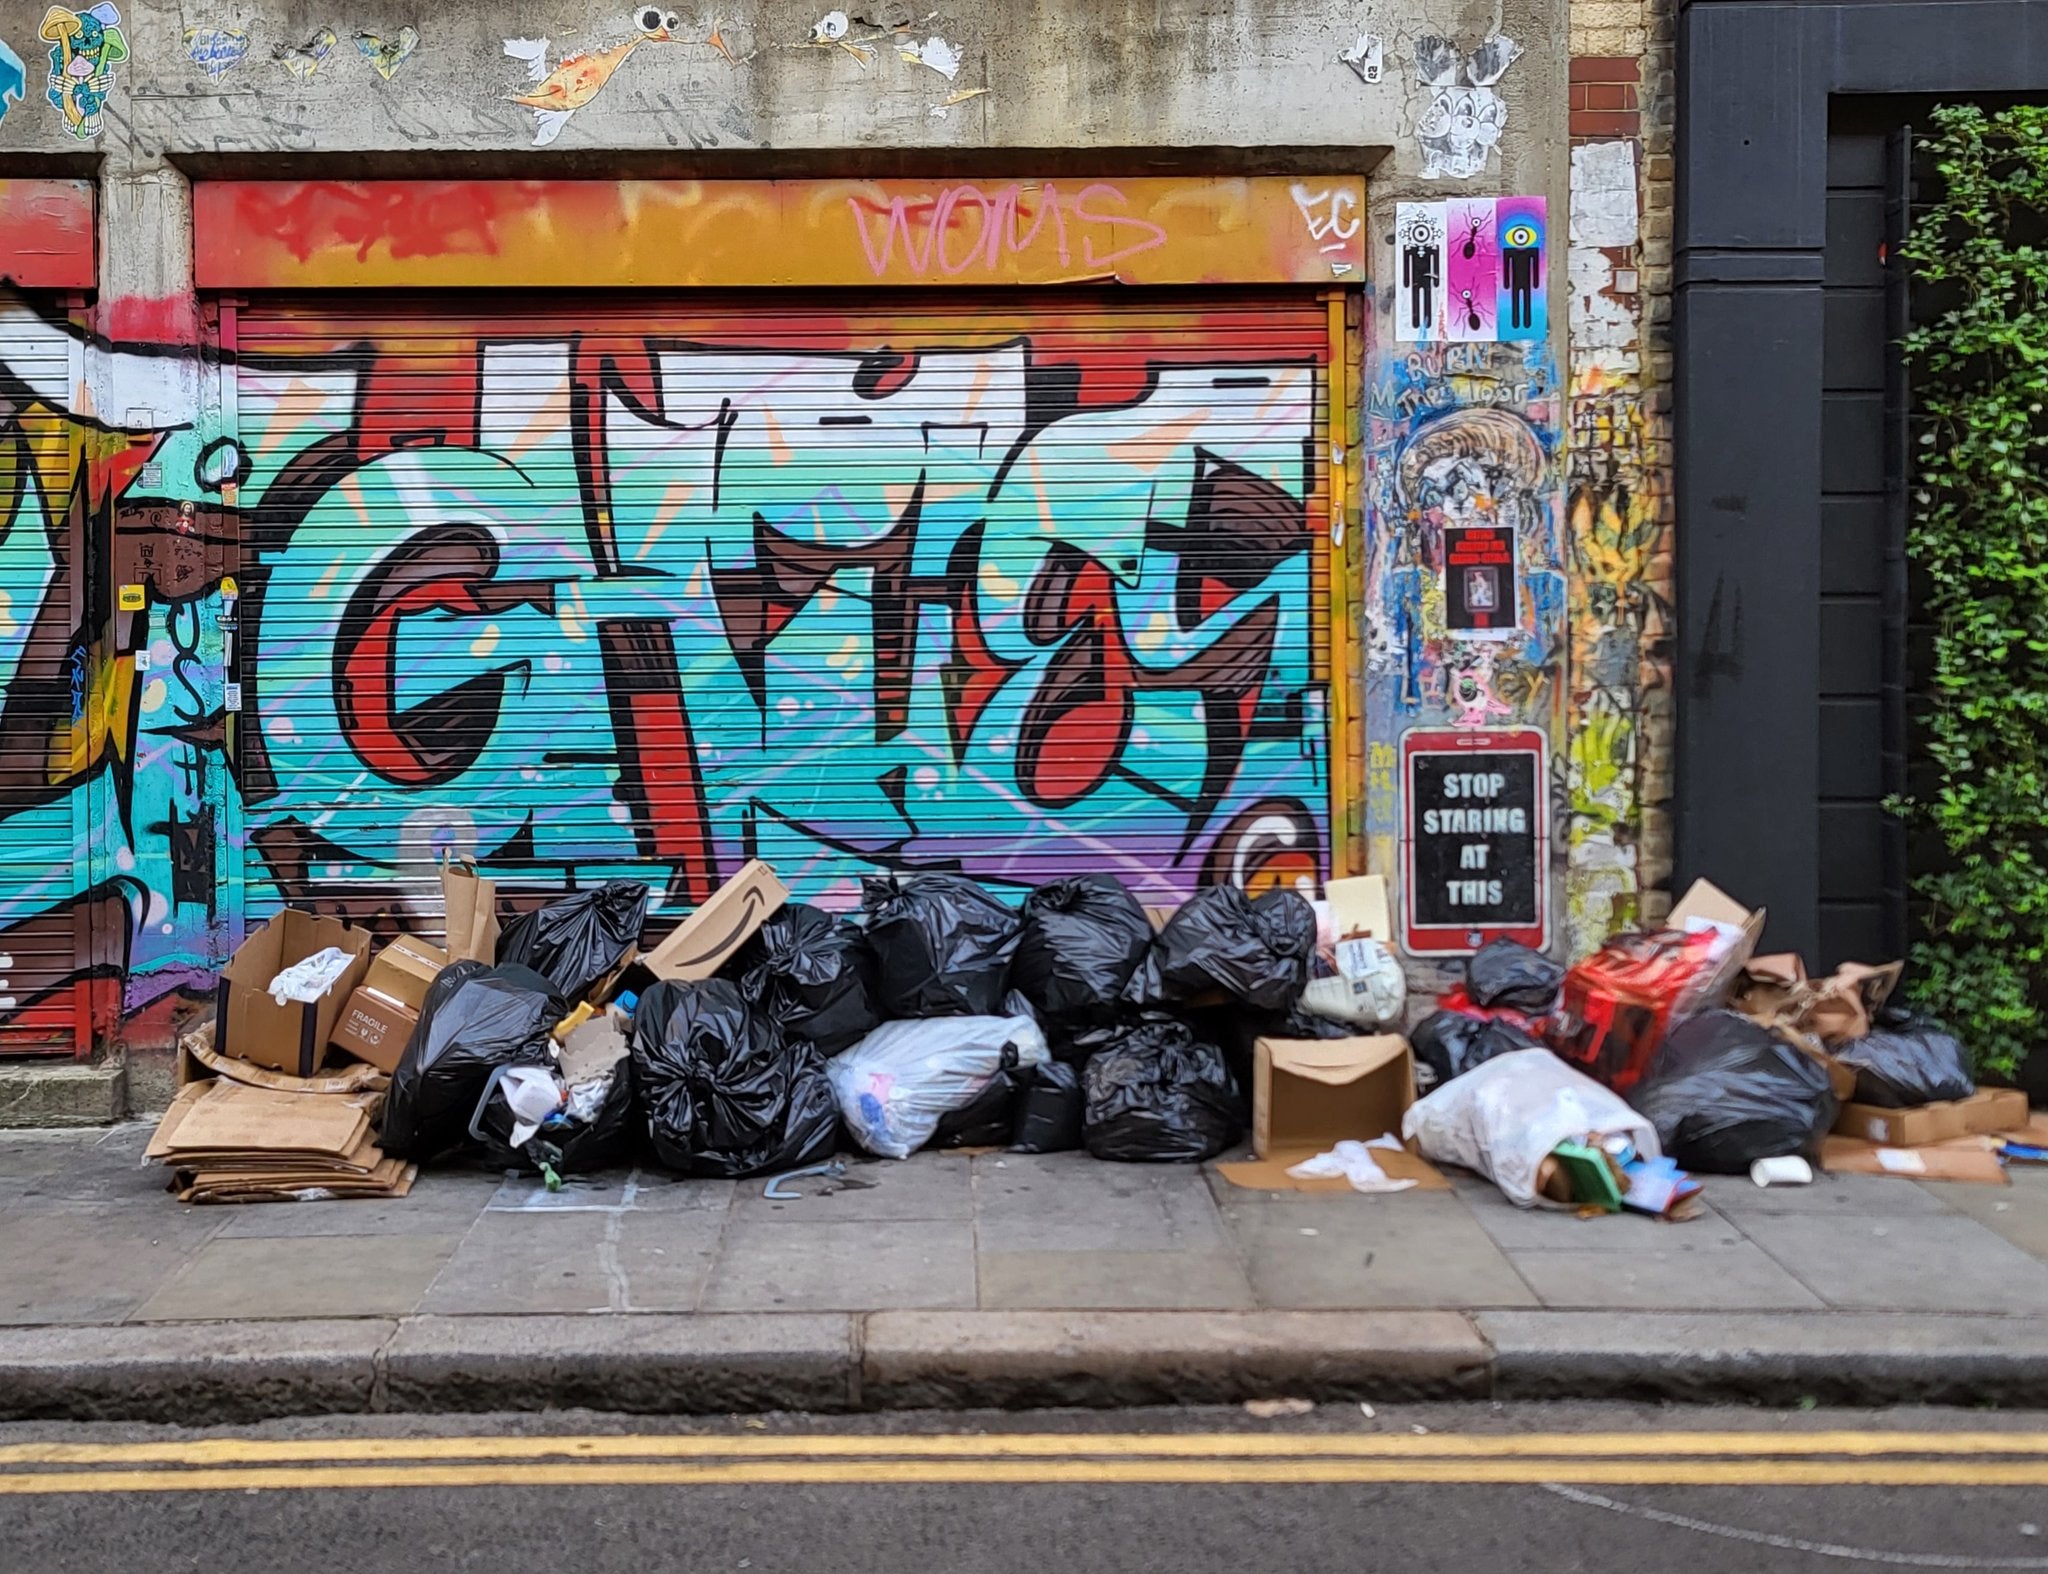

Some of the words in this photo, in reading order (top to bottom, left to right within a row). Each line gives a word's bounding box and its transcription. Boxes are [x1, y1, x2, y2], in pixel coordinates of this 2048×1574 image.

[1443, 773, 1505, 798] STOP
[1423, 808, 1526, 834] STARING
[1460, 844, 1490, 869] AT
[1446, 880, 1503, 905] THIS
[351, 1009, 389, 1035] FRAGILE
